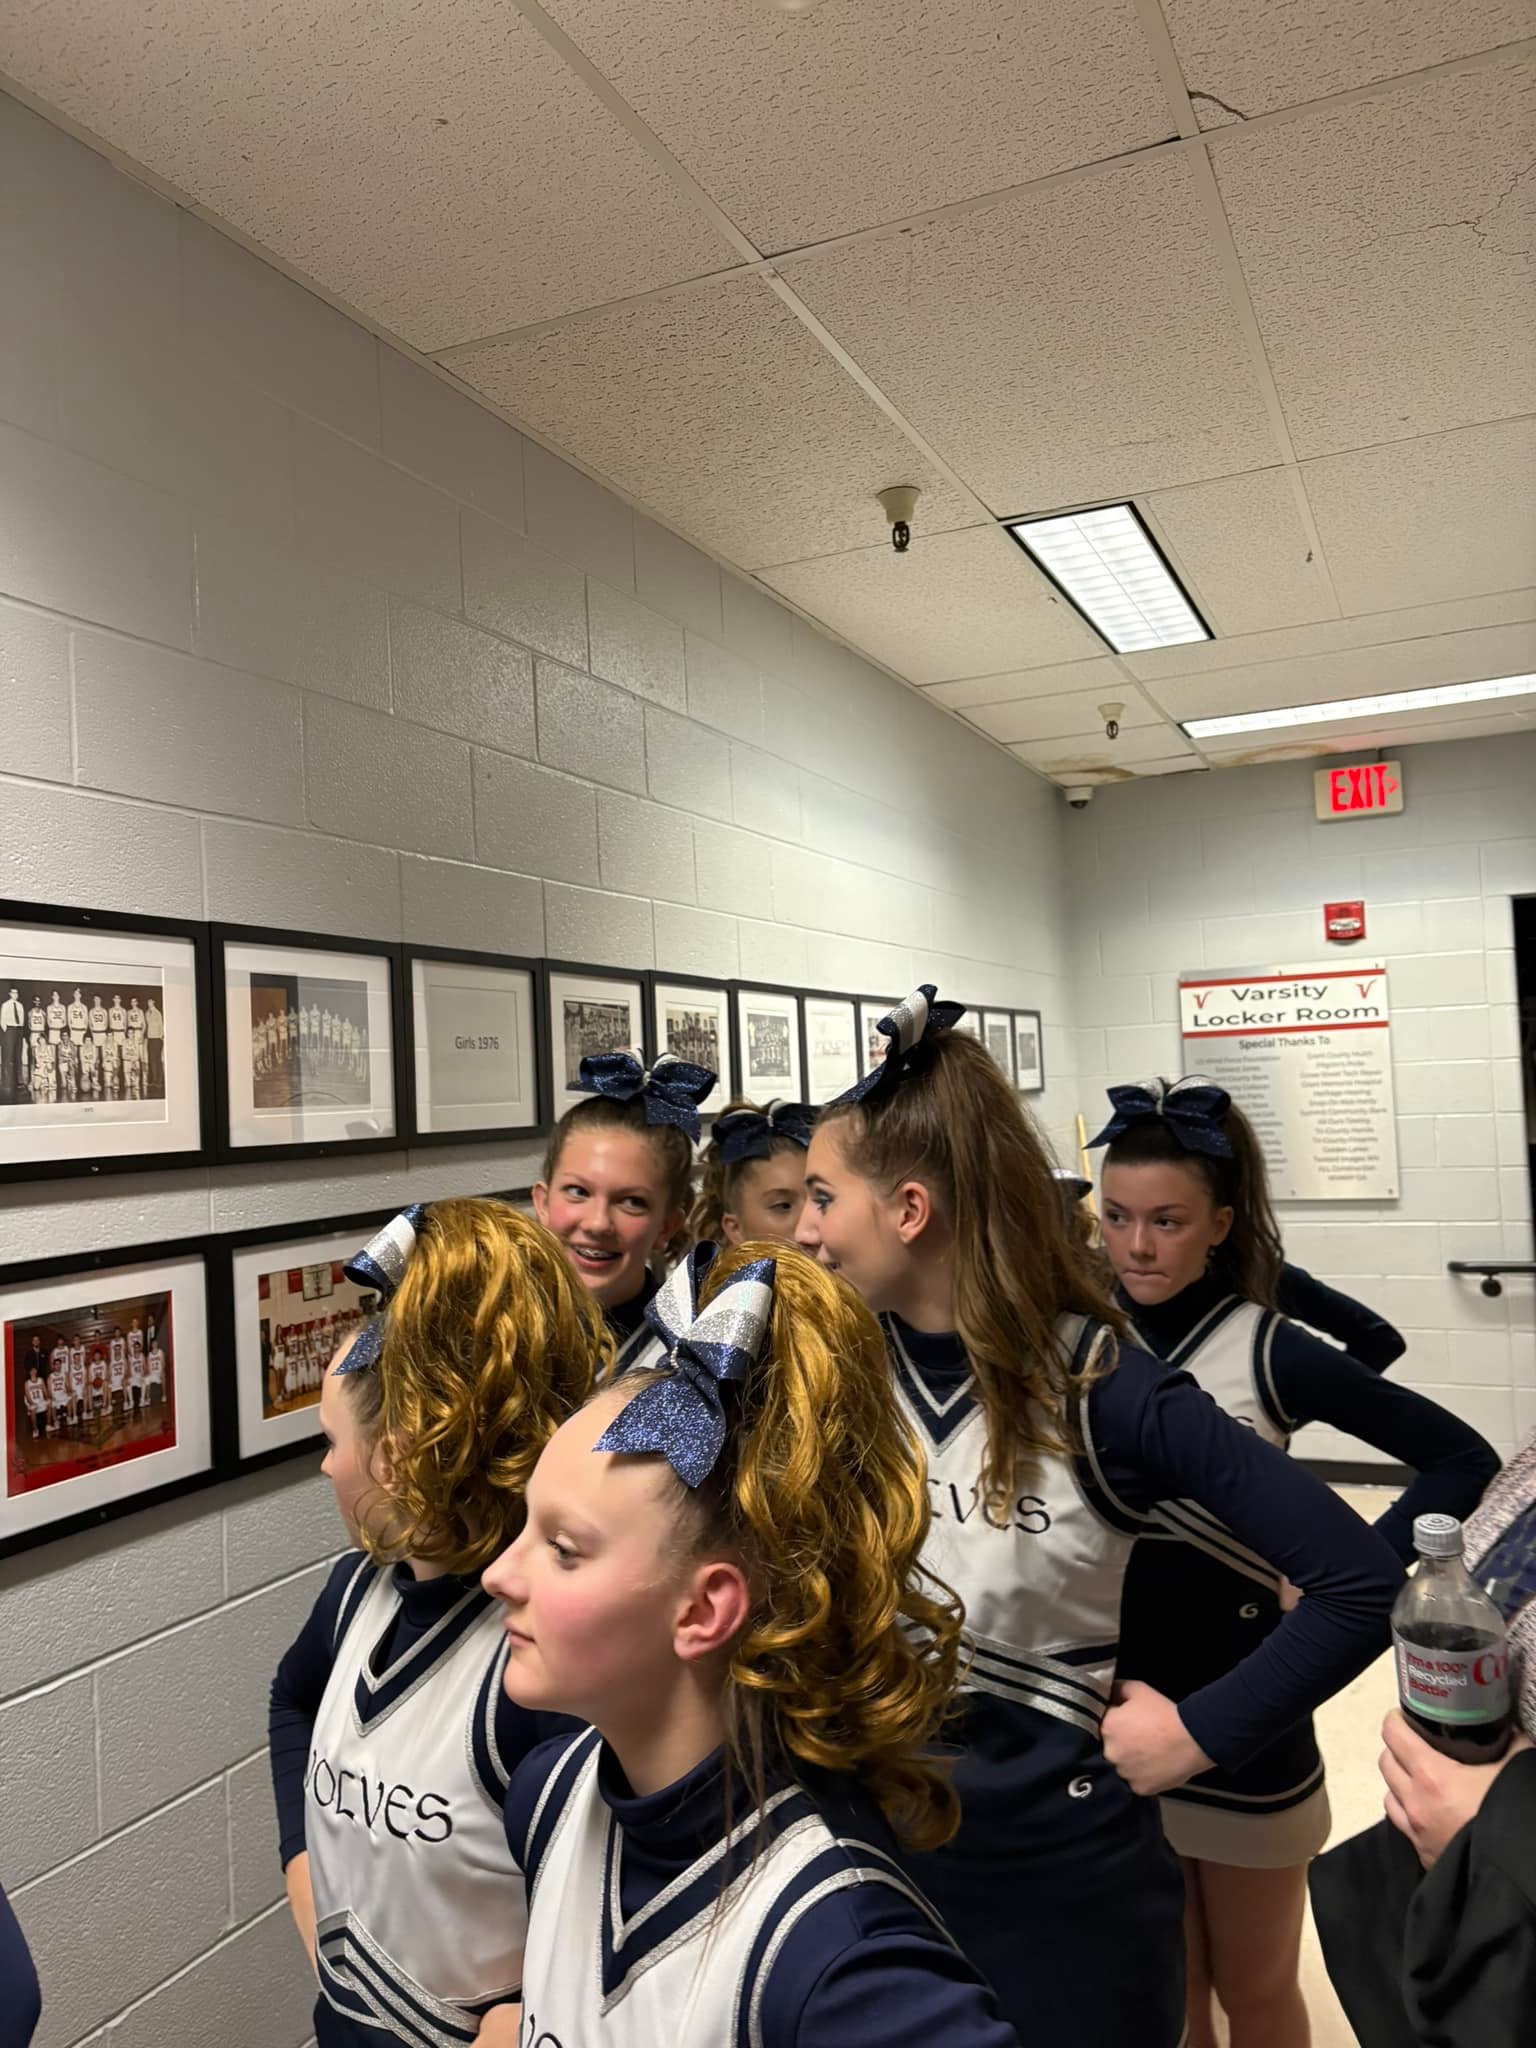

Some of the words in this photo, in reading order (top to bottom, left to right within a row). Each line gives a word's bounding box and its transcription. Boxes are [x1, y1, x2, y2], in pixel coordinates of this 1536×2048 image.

[1330, 765, 1387, 812] EXIT
[1231, 984, 1329, 1001] Varsity
[1193, 1011, 1287, 1028] Locker
[1296, 1005, 1380, 1021] Room
[455, 1035, 476, 1049] Girls
[478, 1036, 499, 1050] 1976
[1238, 1038, 1276, 1051] Special
[1279, 1036, 1316, 1047] Thanks
[1317, 1035, 1331, 1045] To
[1408, 1664, 1468, 1687] Recycled
